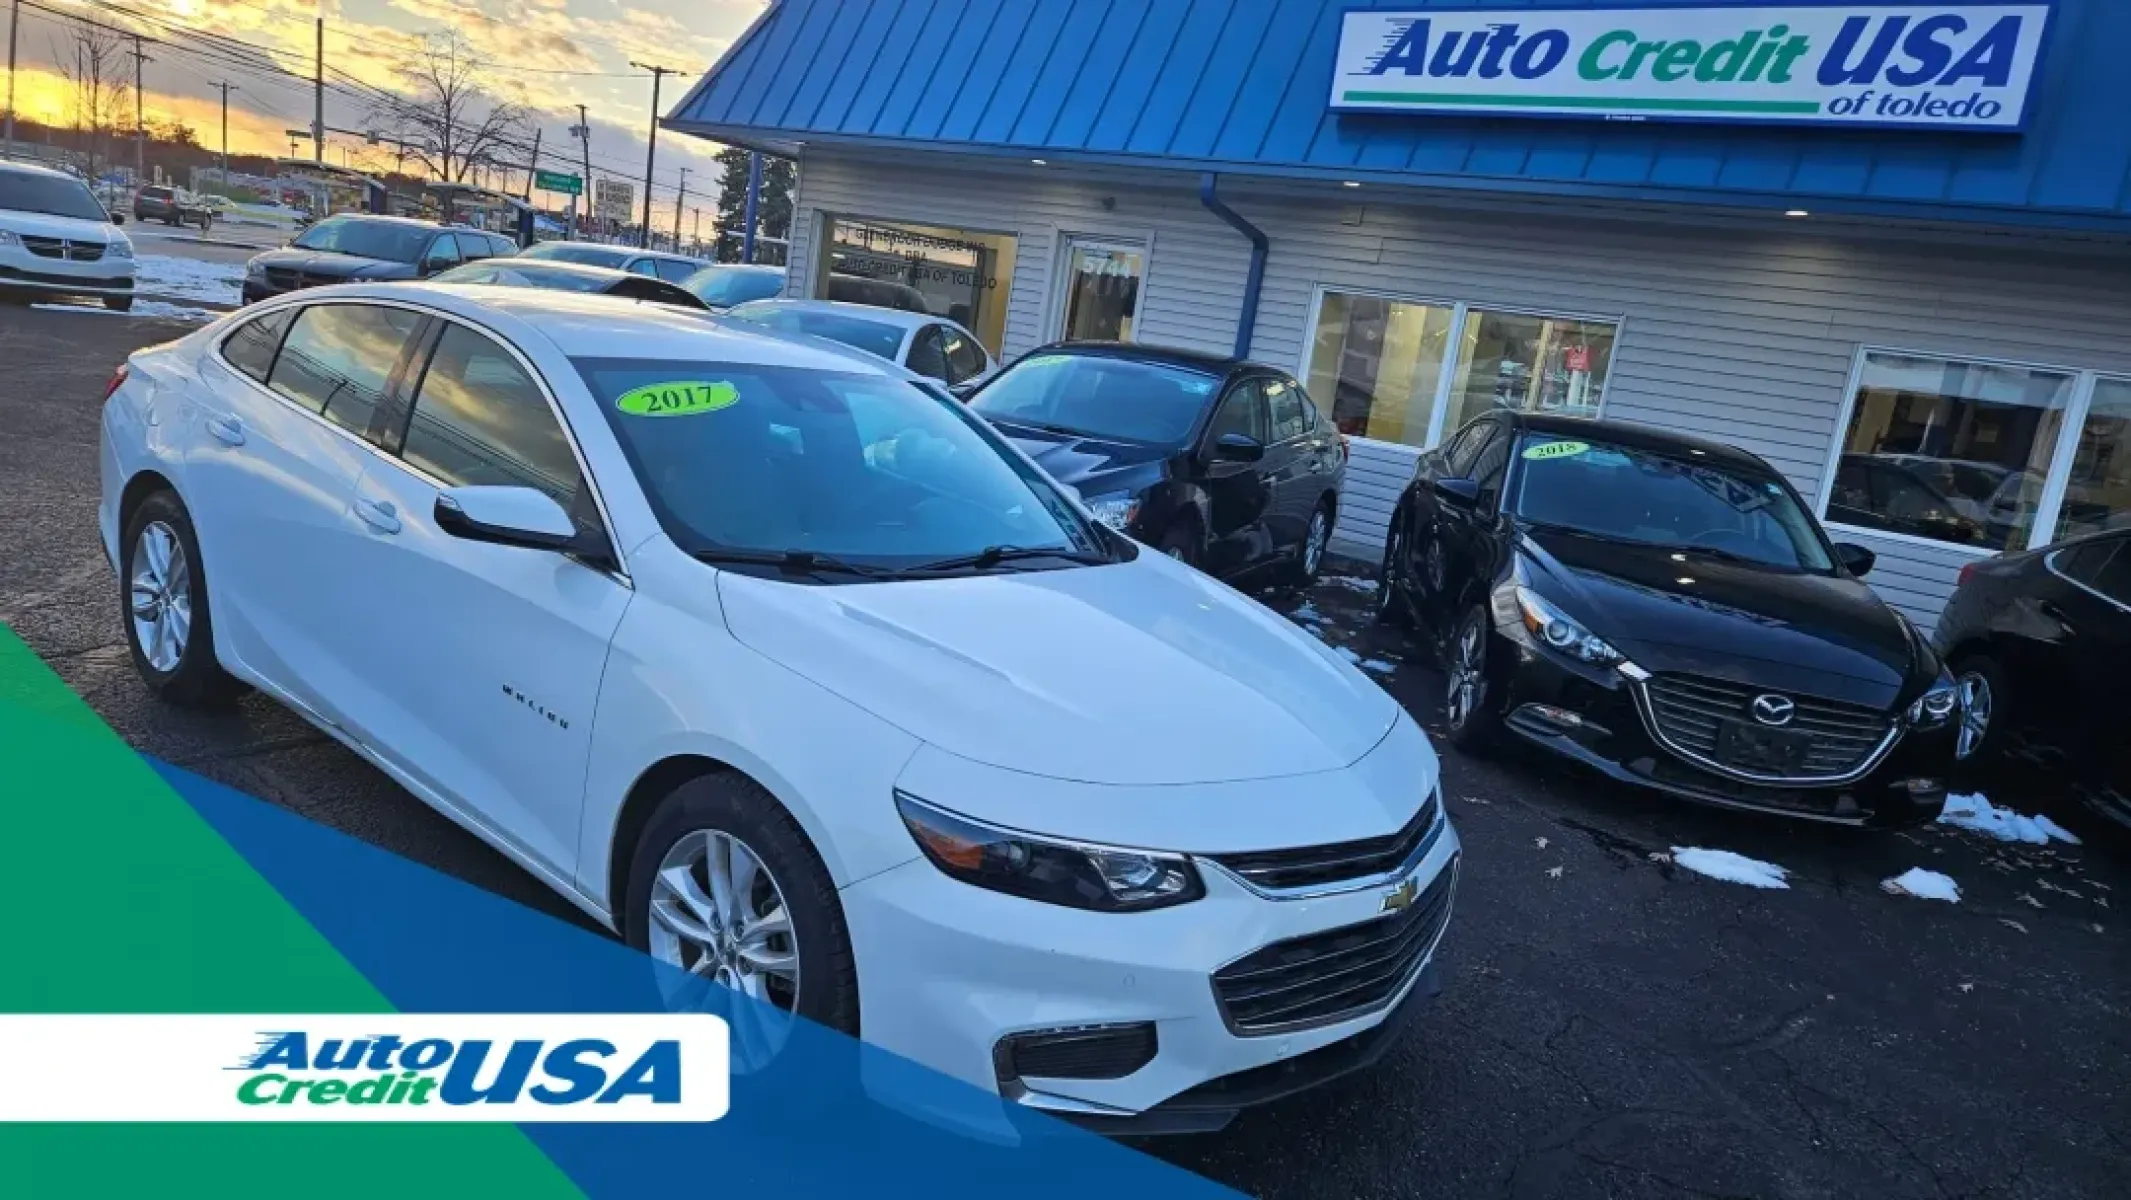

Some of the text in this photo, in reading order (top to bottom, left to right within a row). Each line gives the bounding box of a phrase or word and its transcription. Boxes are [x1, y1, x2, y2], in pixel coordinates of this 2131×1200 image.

[1350, 14, 2023, 87] Auto Credit USA
[1828, 90, 2001, 119] of toledo
[933, 269, 948, 283] OF
[641, 385, 712, 412] 2017
[1536, 443, 1577, 456] 2018
